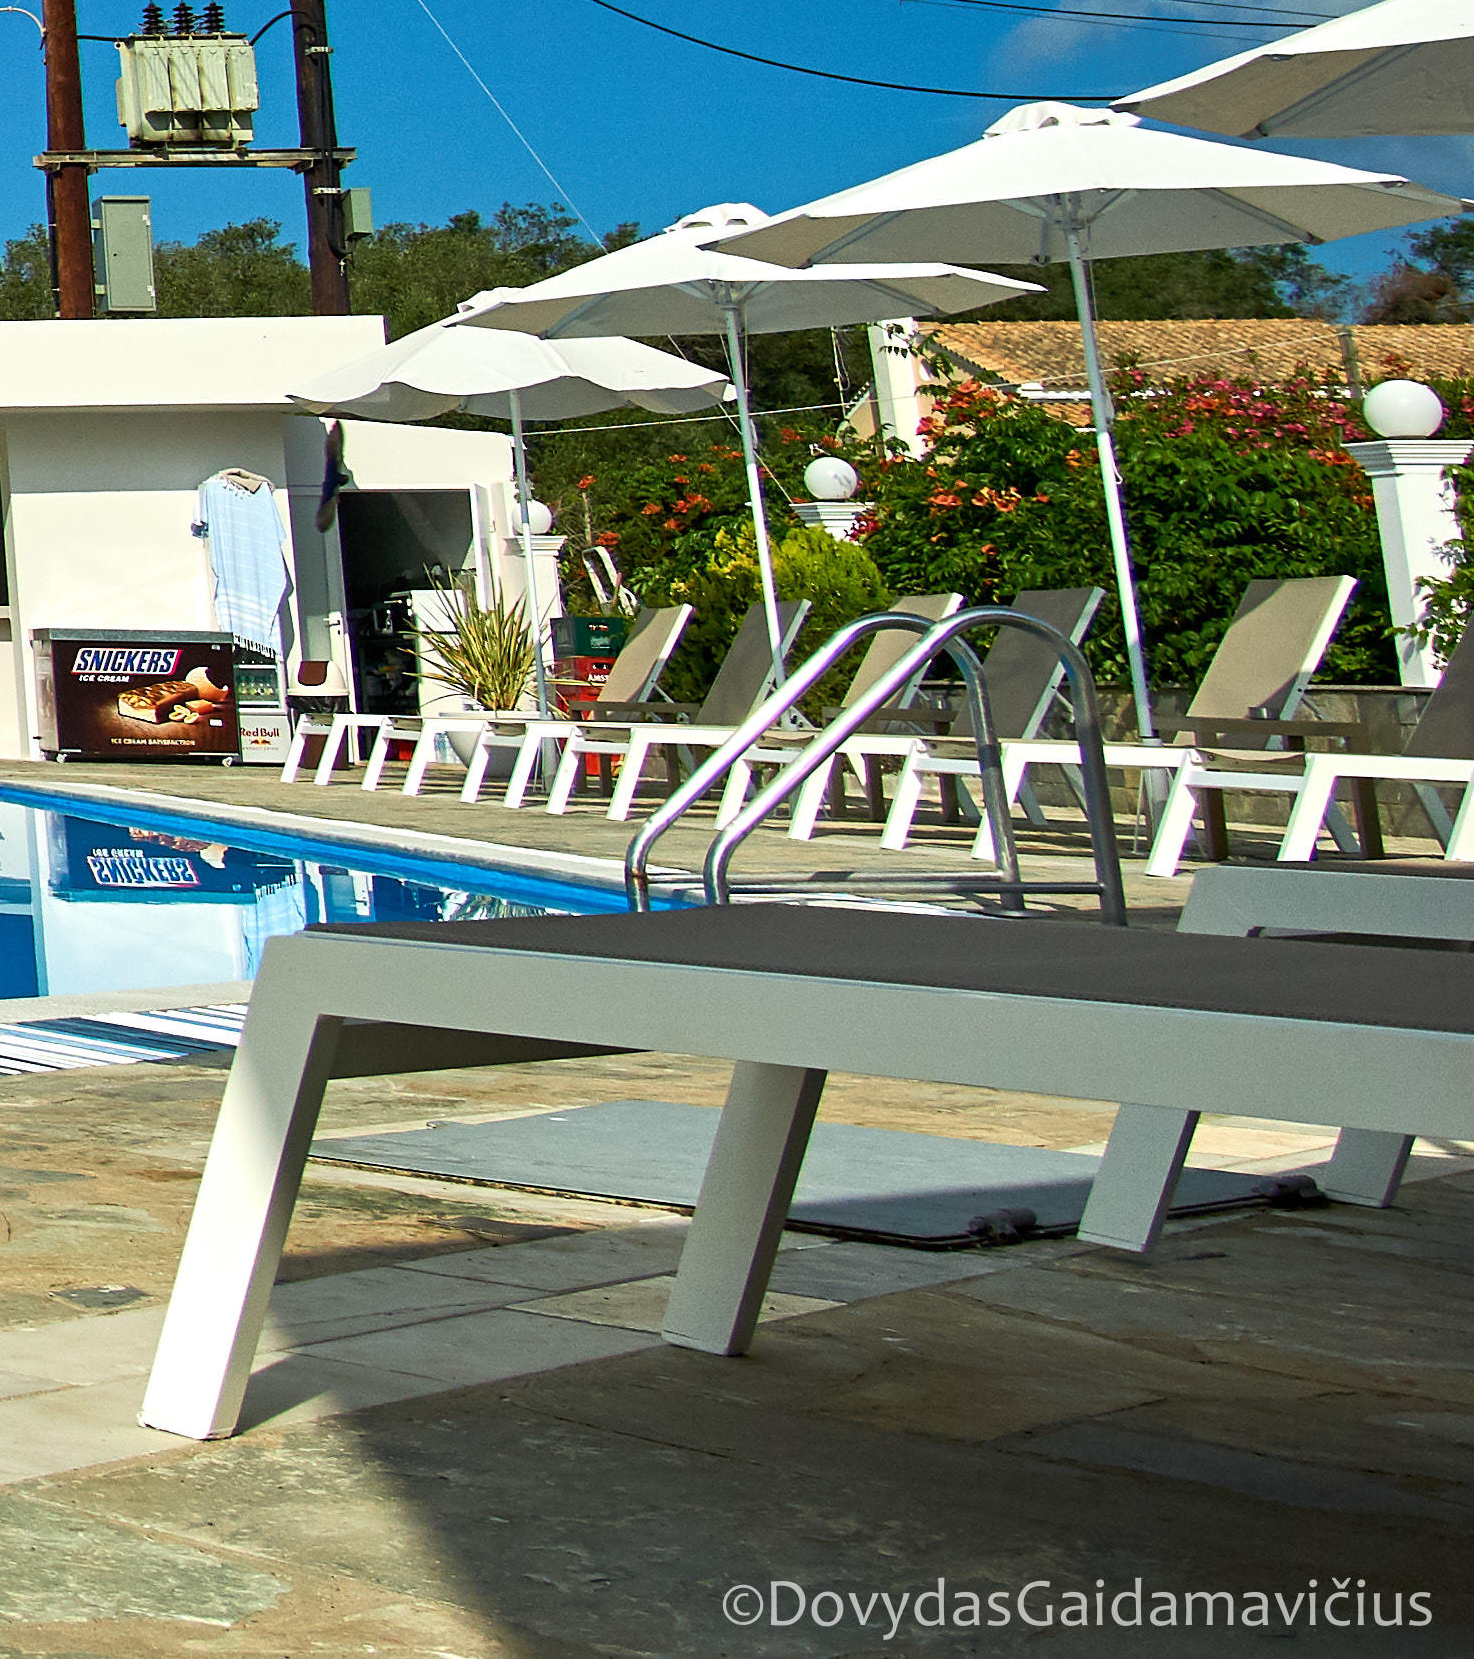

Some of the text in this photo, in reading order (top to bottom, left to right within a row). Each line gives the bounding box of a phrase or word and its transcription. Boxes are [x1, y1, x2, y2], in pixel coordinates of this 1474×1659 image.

[76, 649, 176, 673] SNICKERS
[97, 675, 130, 683] CREAM
[240, 727, 280, 737] Red Bull
